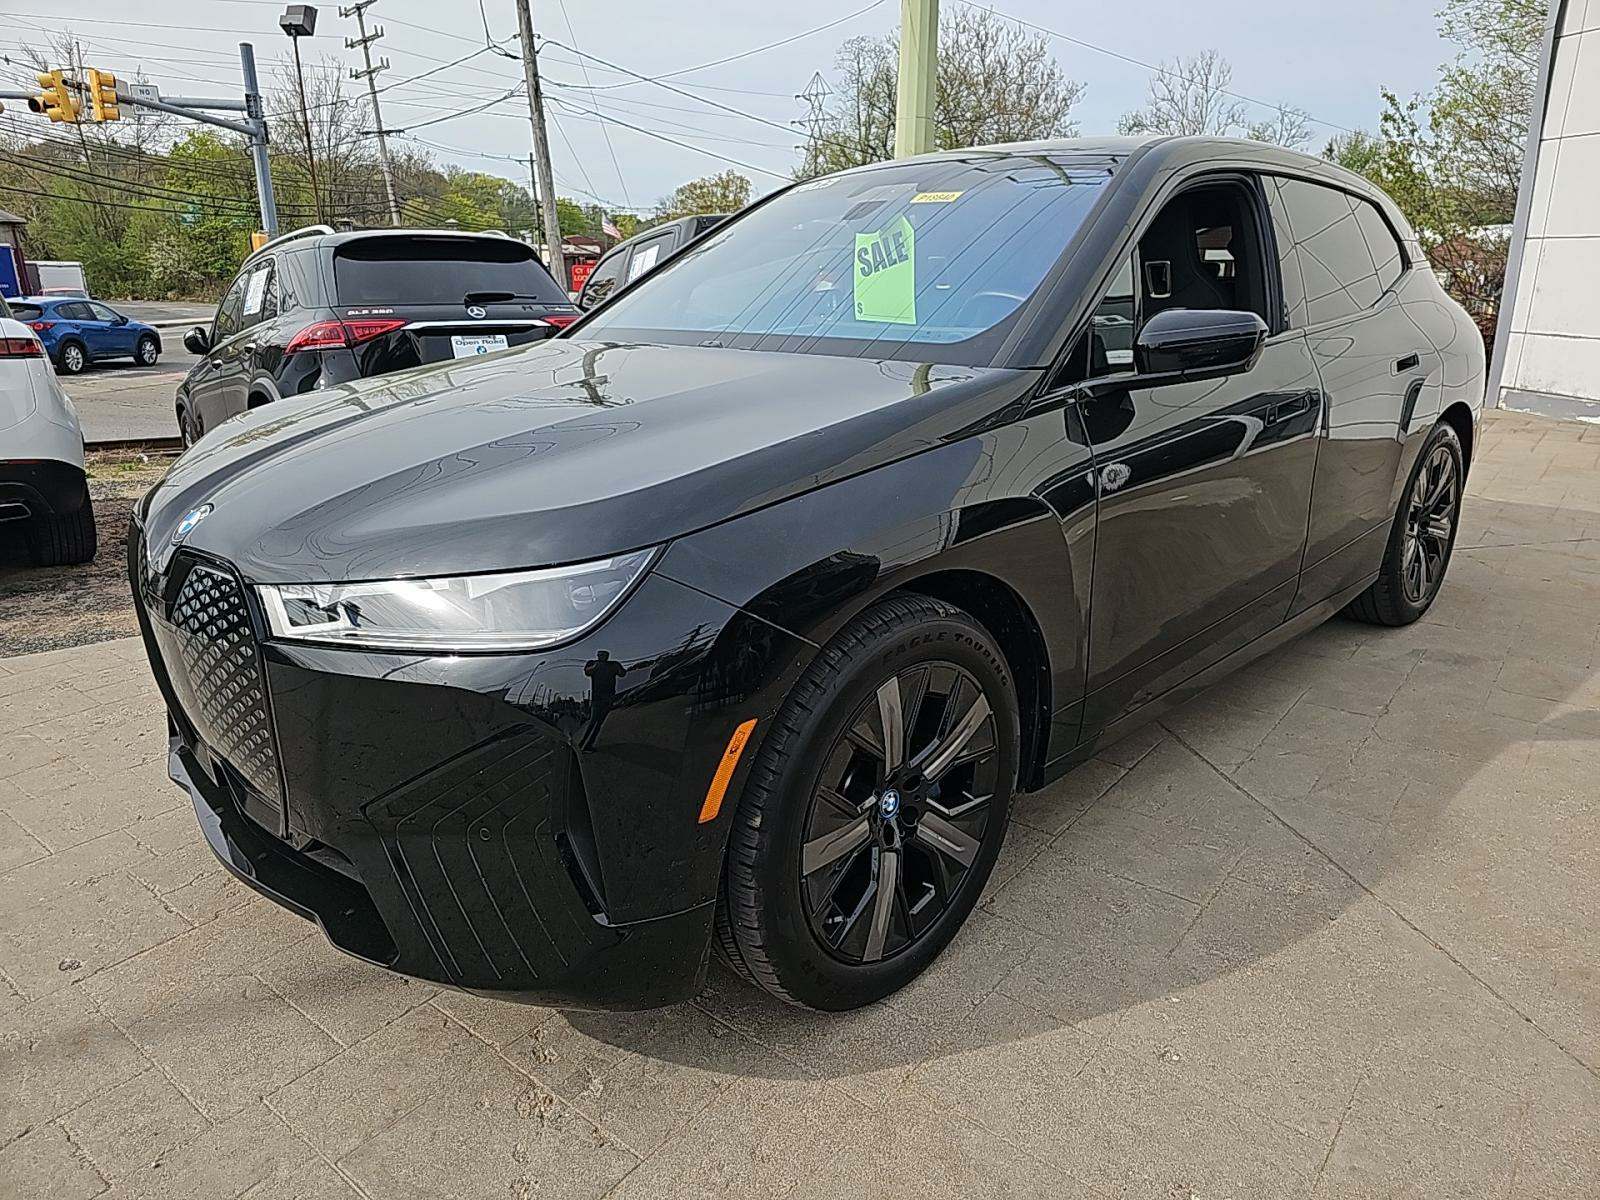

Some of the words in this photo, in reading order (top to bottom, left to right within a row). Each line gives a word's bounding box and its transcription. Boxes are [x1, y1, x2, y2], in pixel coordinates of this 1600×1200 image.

[139, 88, 150, 96] NO
[857, 231, 909, 277] SALE
[857, 302, 863, 315] $
[953, 632, 1009, 687] TOURING
